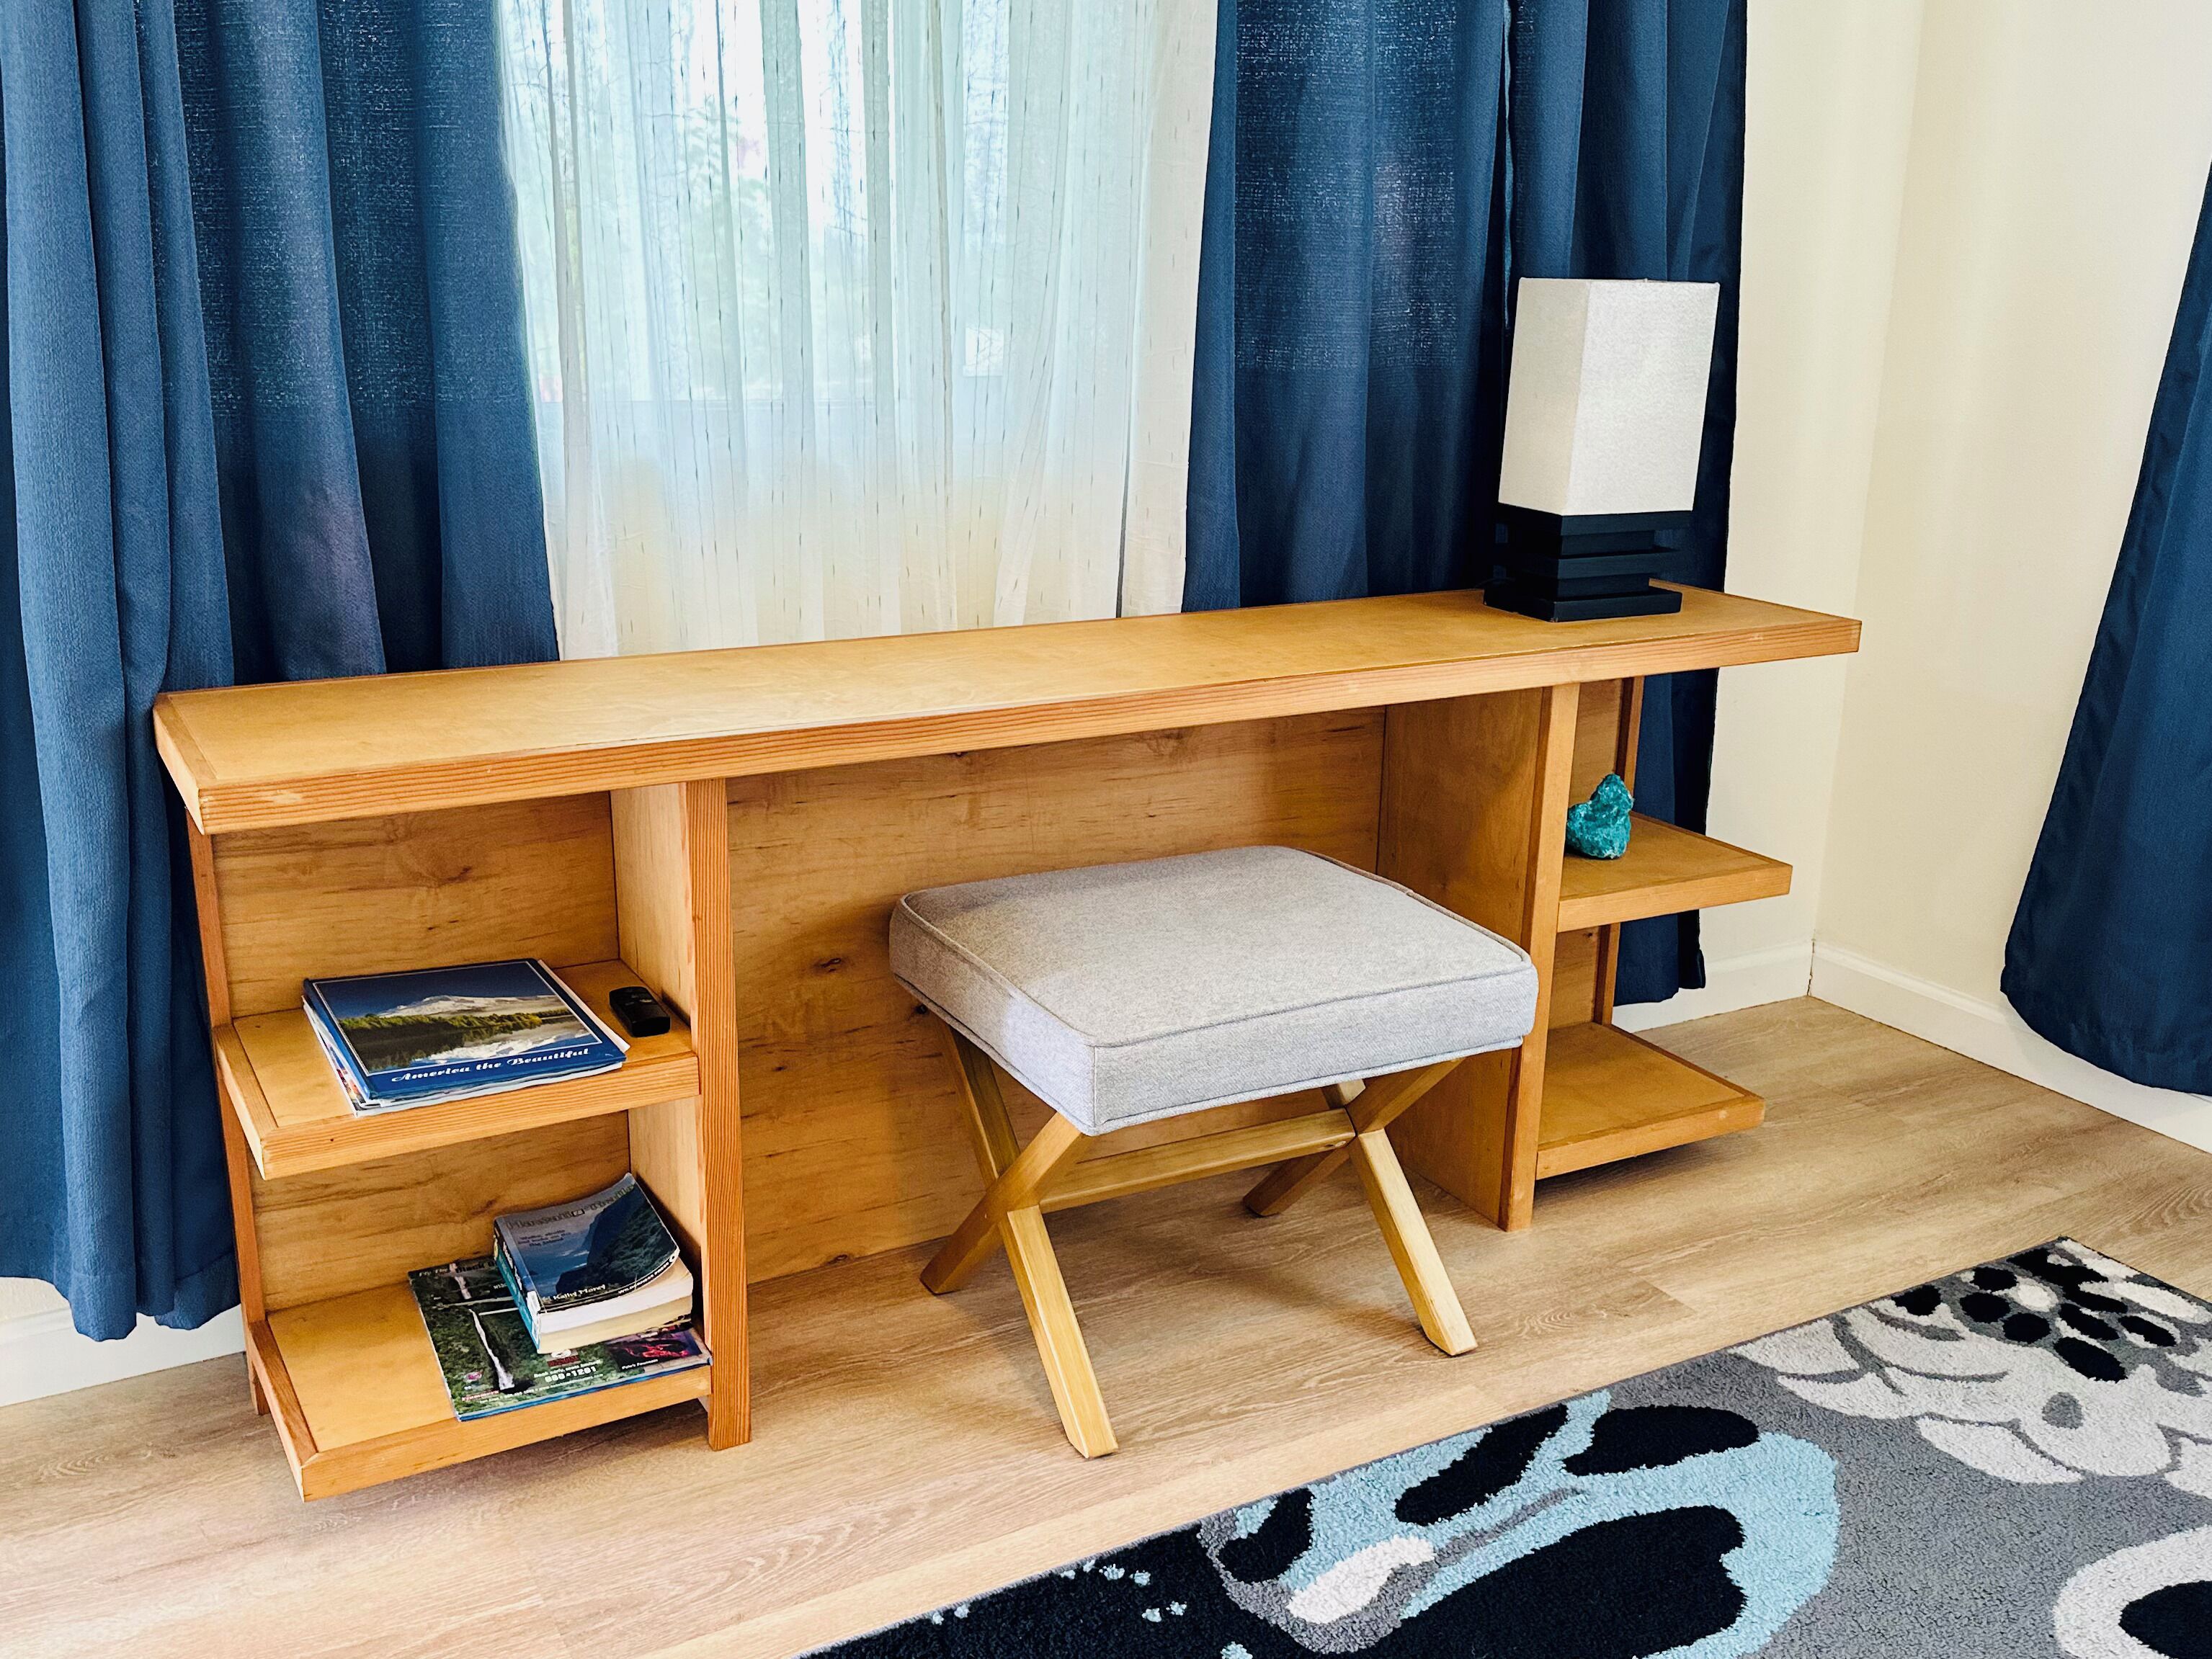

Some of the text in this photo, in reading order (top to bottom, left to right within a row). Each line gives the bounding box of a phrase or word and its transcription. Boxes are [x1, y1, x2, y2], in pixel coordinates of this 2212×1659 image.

[391, 1048, 589, 1082] America the Beautiful
